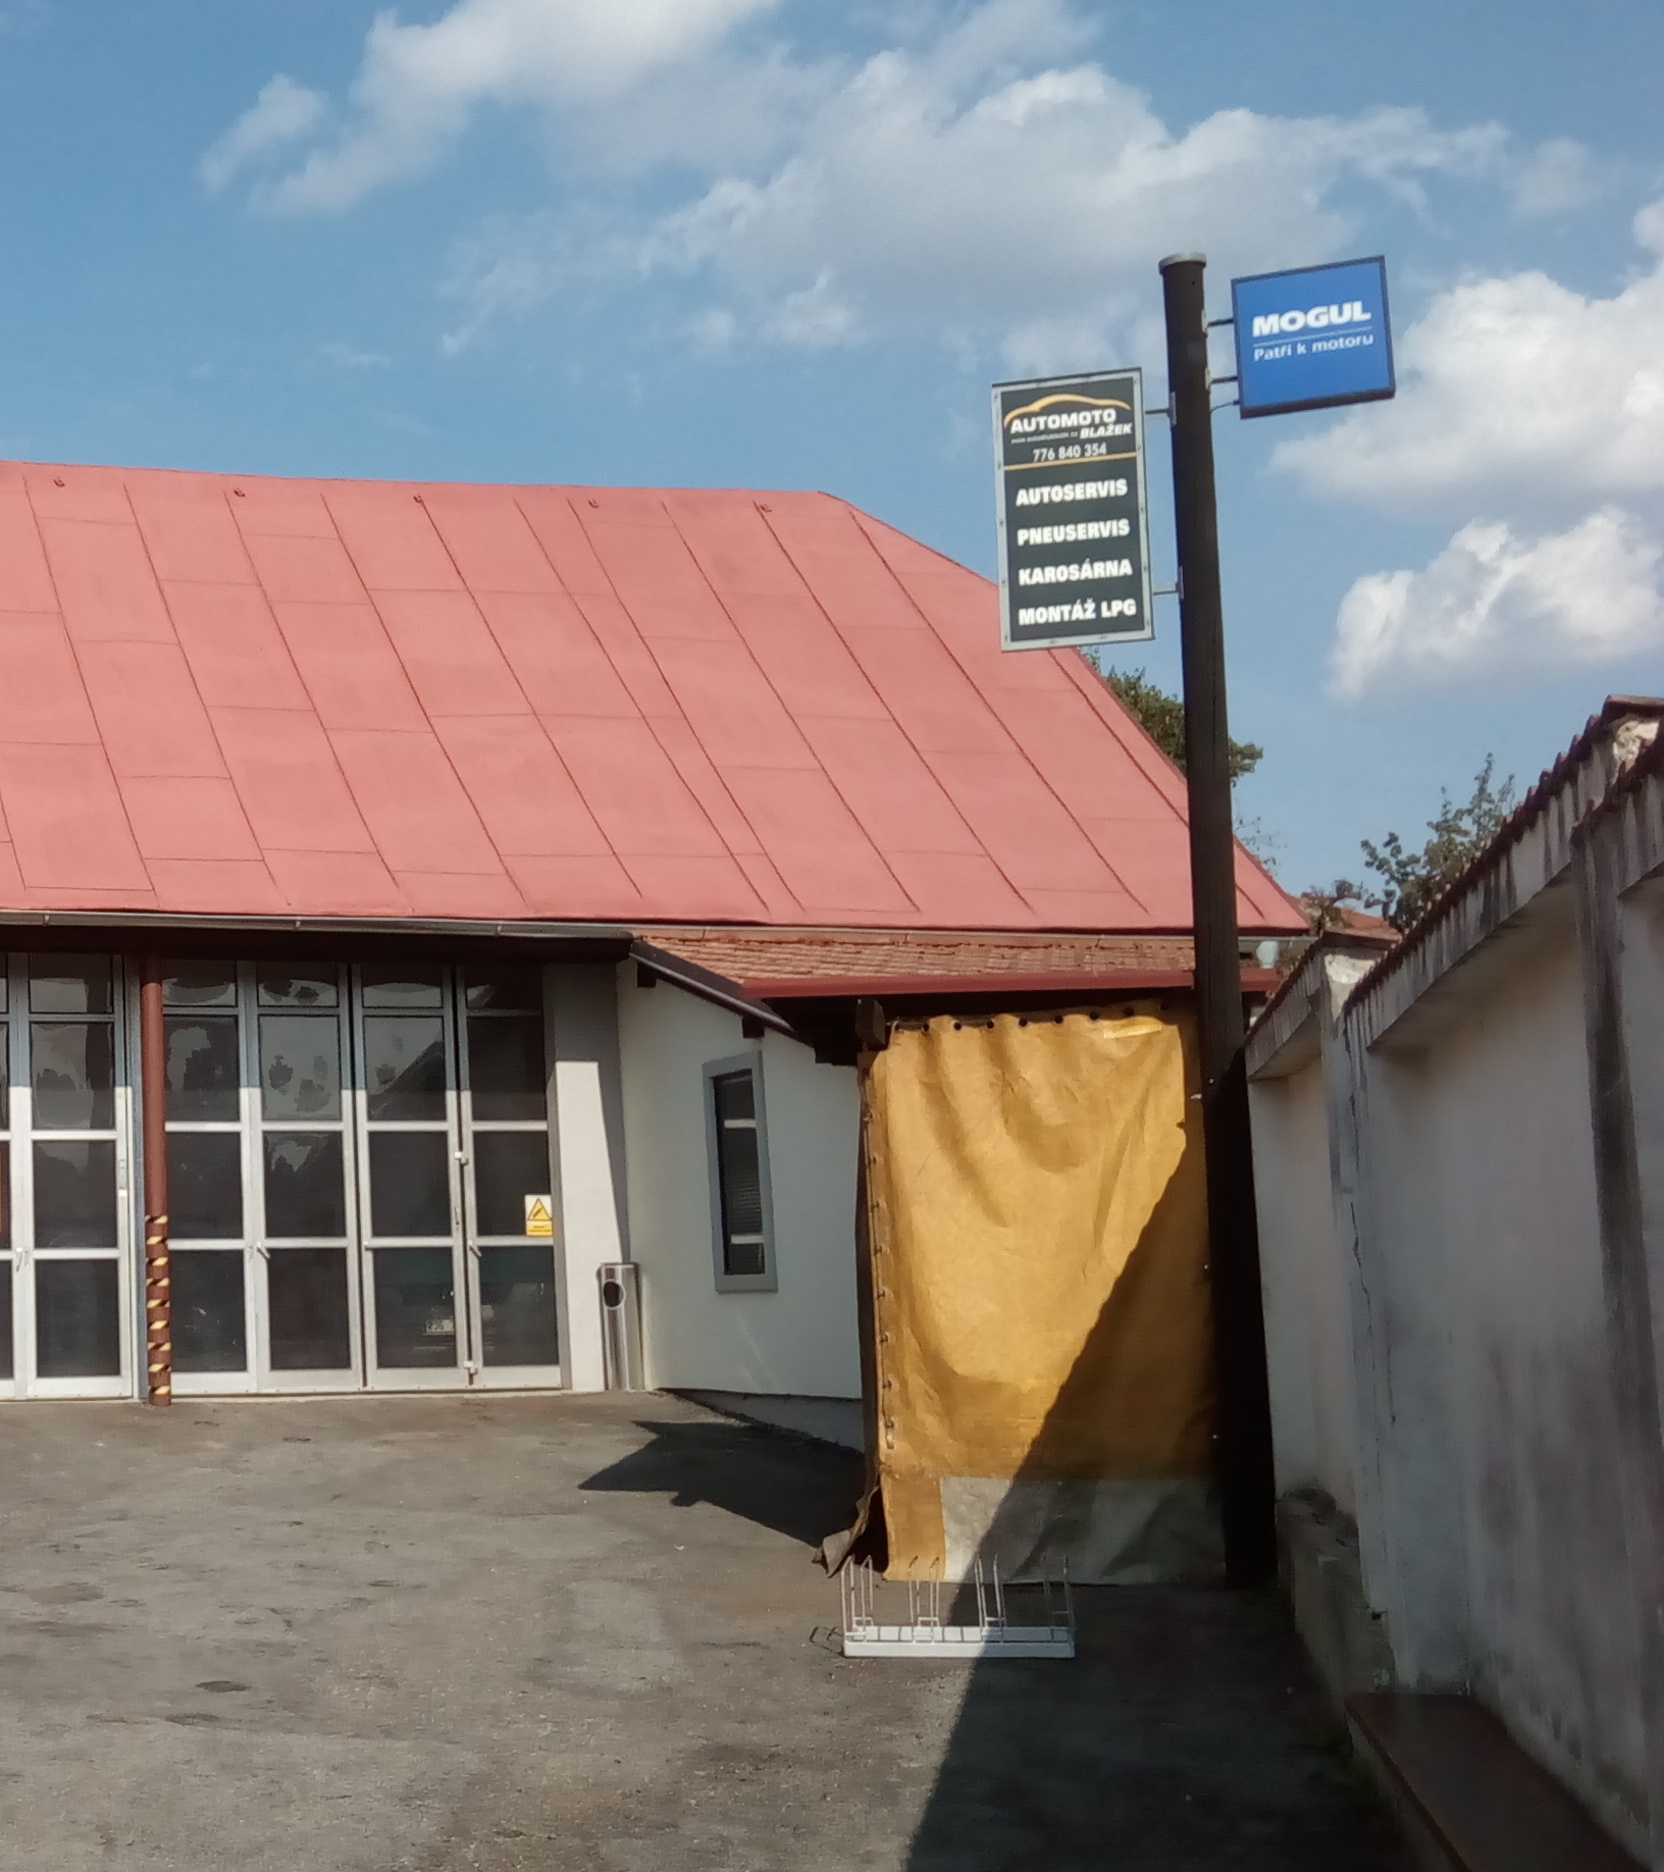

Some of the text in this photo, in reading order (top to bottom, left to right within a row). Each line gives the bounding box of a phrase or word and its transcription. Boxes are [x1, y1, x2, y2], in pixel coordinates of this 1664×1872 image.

[1252, 301, 1372, 338] MOGUL
[1296, 342, 1307, 355] k
[1312, 334, 1375, 353] motoru
[1010, 408, 1117, 434] AUTOMOTO
[1079, 423, 1133, 440] BLAŽEK
[1032, 442, 1107, 463] 776 840 354
[1015, 478, 1128, 507] AUTOSERVIS
[1017, 518, 1131, 546] PNEUSERVIS
[1018, 558, 1133, 587] KAROSÁRNA
[1018, 598, 1137, 626] MONTÁŽ LPG
